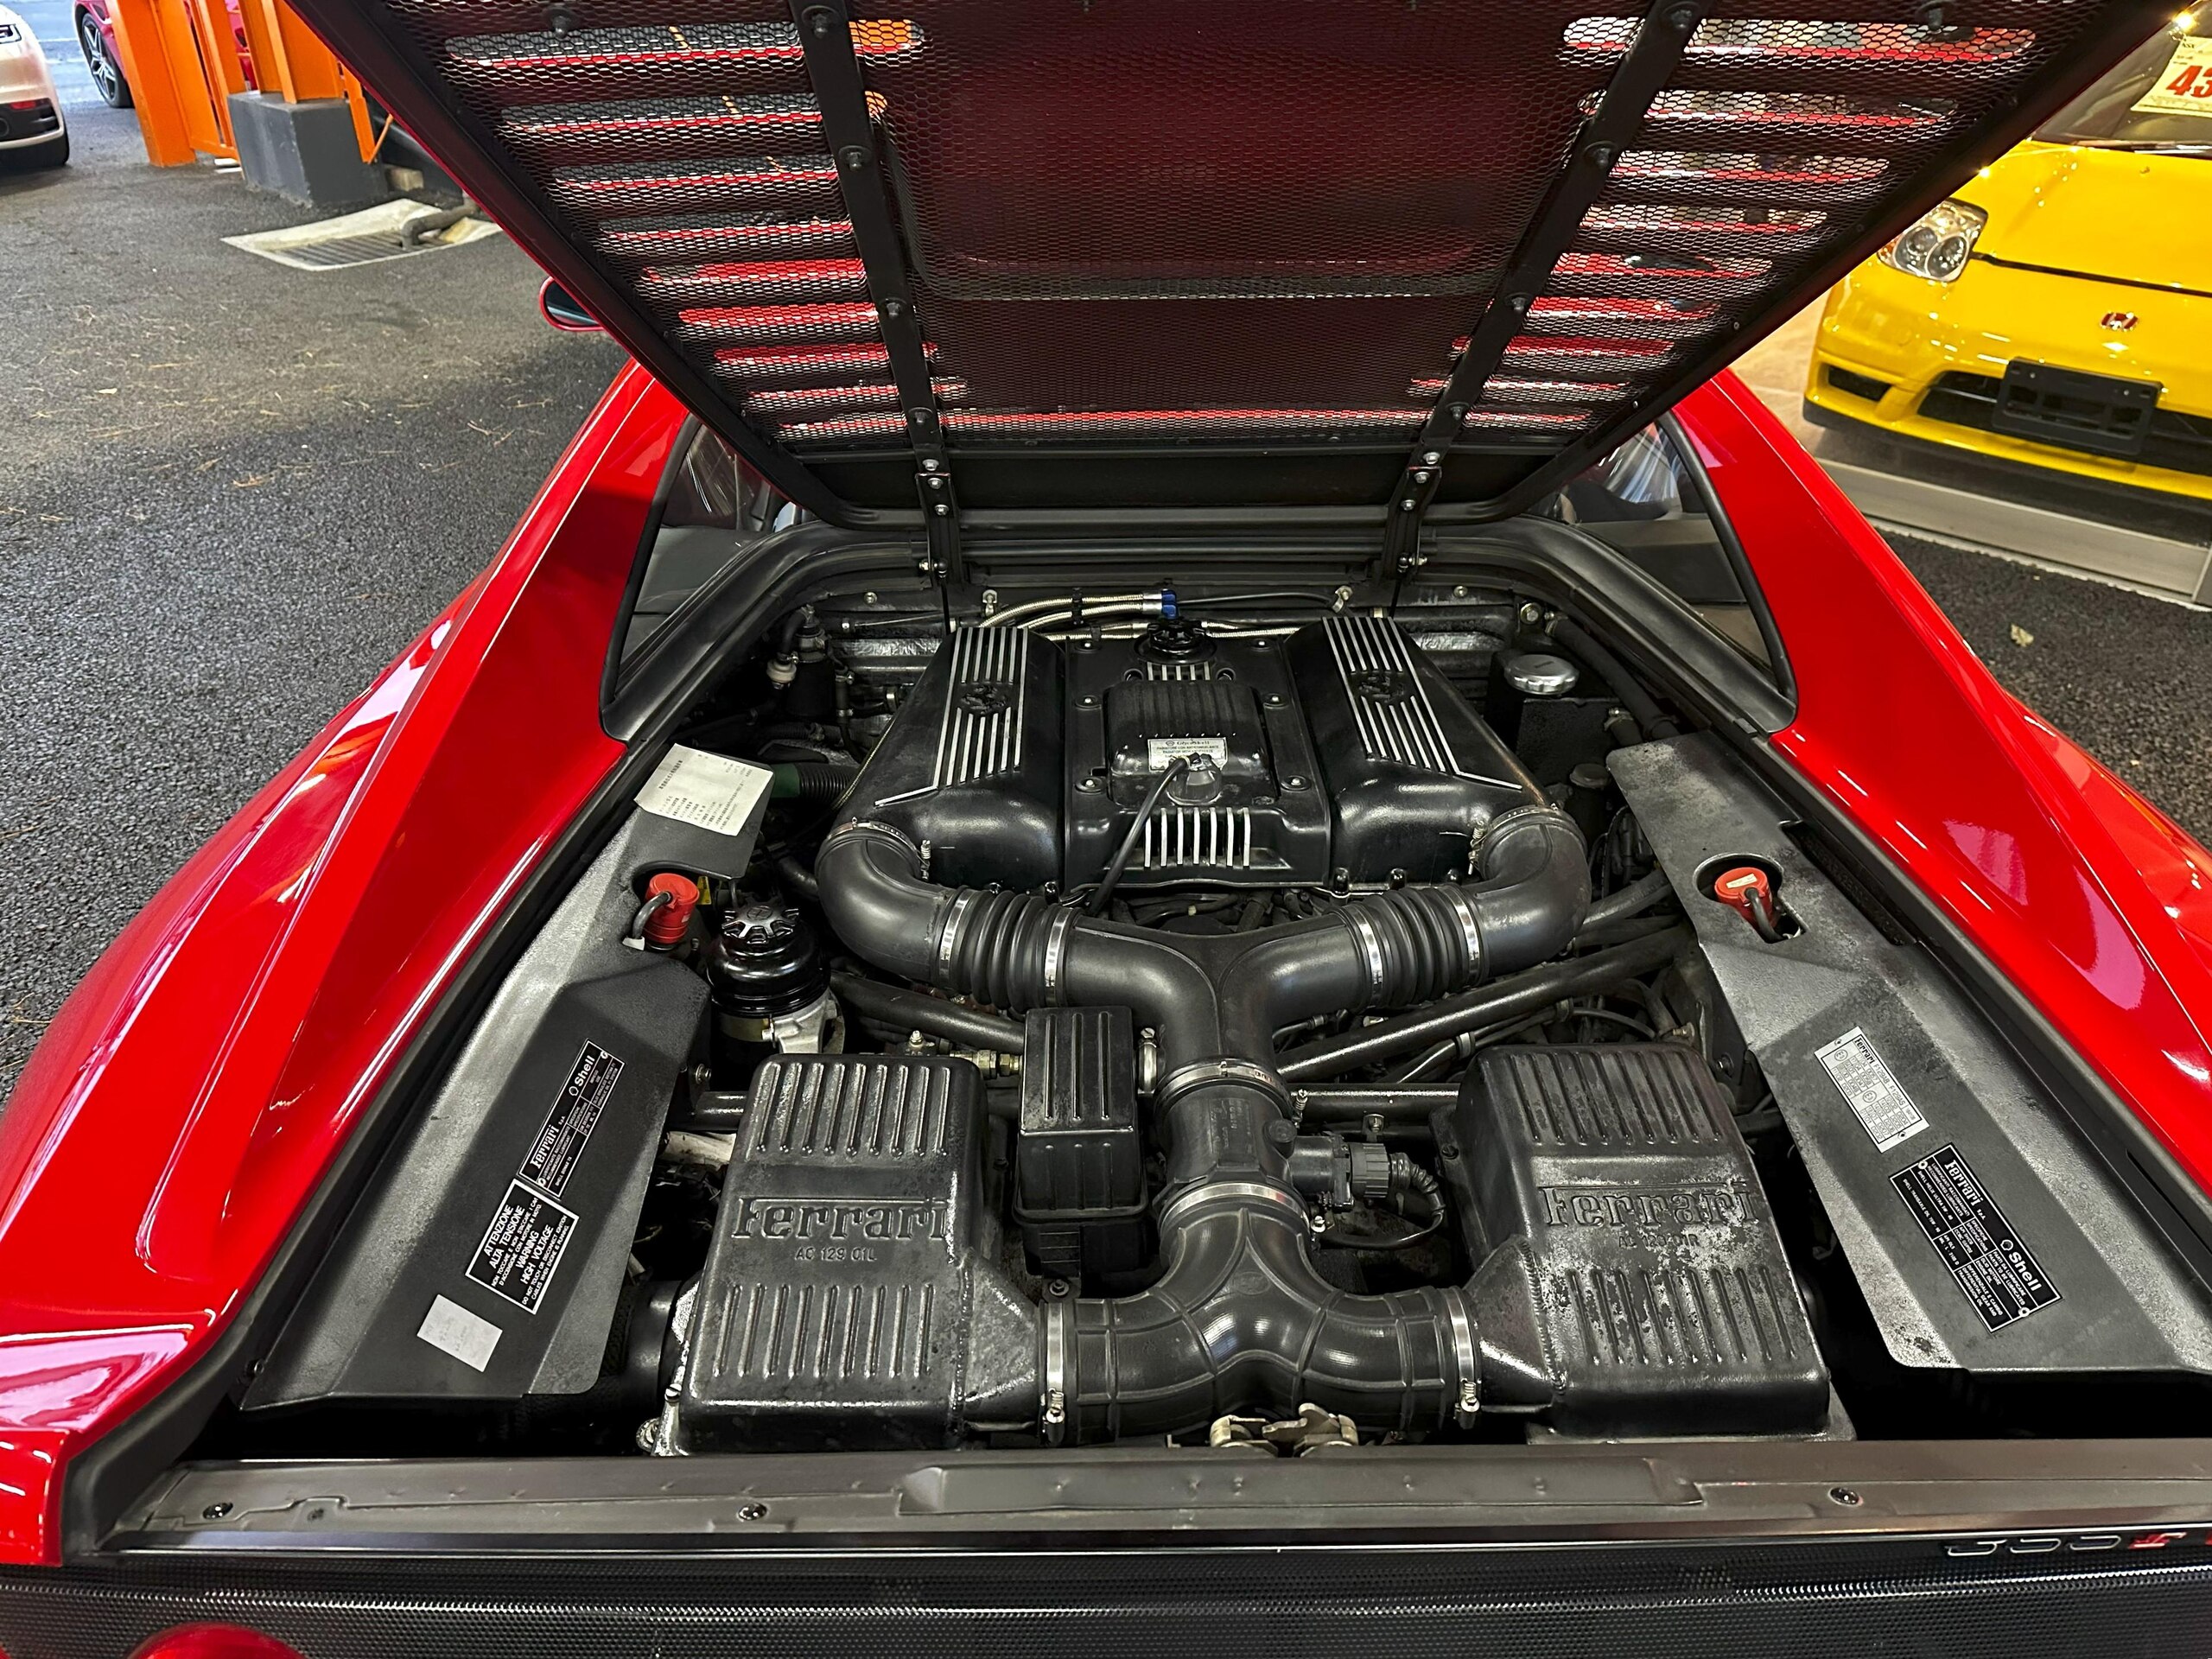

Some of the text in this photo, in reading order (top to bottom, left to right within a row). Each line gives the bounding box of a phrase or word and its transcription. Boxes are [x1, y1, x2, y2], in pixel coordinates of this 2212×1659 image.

[1854, 1037, 1875, 1064] Ferrari
[529, 1124, 559, 1168] Ferrari
[574, 1054, 594, 1086] Shell
[1538, 1180, 1758, 1227] Ferrari
[1931, 1162, 1970, 1216] LUBRIFICANTI RACCOMANDATI
[1945, 1192, 1963, 1216] LUBRICANTS
[483, 1204, 513, 1255] ATTENZIONE
[488, 1205, 524, 1268] ALTA TENSIONE
[514, 1241, 523, 1252] CON
[520, 1223, 532, 1241] MOTORE
[731, 1197, 950, 1239] Ferrari
[1943, 1159, 1983, 1205] Ferrari
[2008, 1251, 2042, 1291] Shell
[1966, 1222, 1988, 1251] SPECIFICATIONS
[1971, 1219, 1987, 1241] SPECIFICHE
[491, 1274, 499, 1287] NON
[496, 1252, 511, 1274] TOCCARE
[510, 1235, 518, 1247] NON
[517, 1211, 531, 1234] STACCARE
[515, 1230, 539, 1268] WARNING
[519, 1224, 553, 1284] HIGH VOLTAGE
[521, 1296, 528, 1305] DO
[530, 1269, 541, 1285] TOUCH
[538, 1261, 544, 1269] OR
[542, 1233, 557, 1261] DISCONNECT
[555, 1214, 567, 1233] IGNITION
[795, 1246, 816, 1261] AC
[821, 1246, 846, 1261] 129
[1975, 1260, 1987, 1275] ENGINE
[1980, 1257, 2001, 1285] OLIO MOTORE
[1993, 1250, 2003, 1263] PARTI
[2005, 1269, 2026, 1296] LUBRIFICARE
[531, 1281, 542, 1300] CABLES
[539, 1267, 549, 1281] WHEN
[546, 1249, 556, 1267] ENGINE
[1961, 1267, 1997, 1316] DIFFERENTIAL GEAR AND
[1967, 1264, 1989, 1294] DIFFERENZIALE
[1989, 1298, 2003, 1315] CAMBIO
[1987, 1253, 1999, 1267] PARTS
[2005, 1279, 2025, 1305] LUBRICATED
